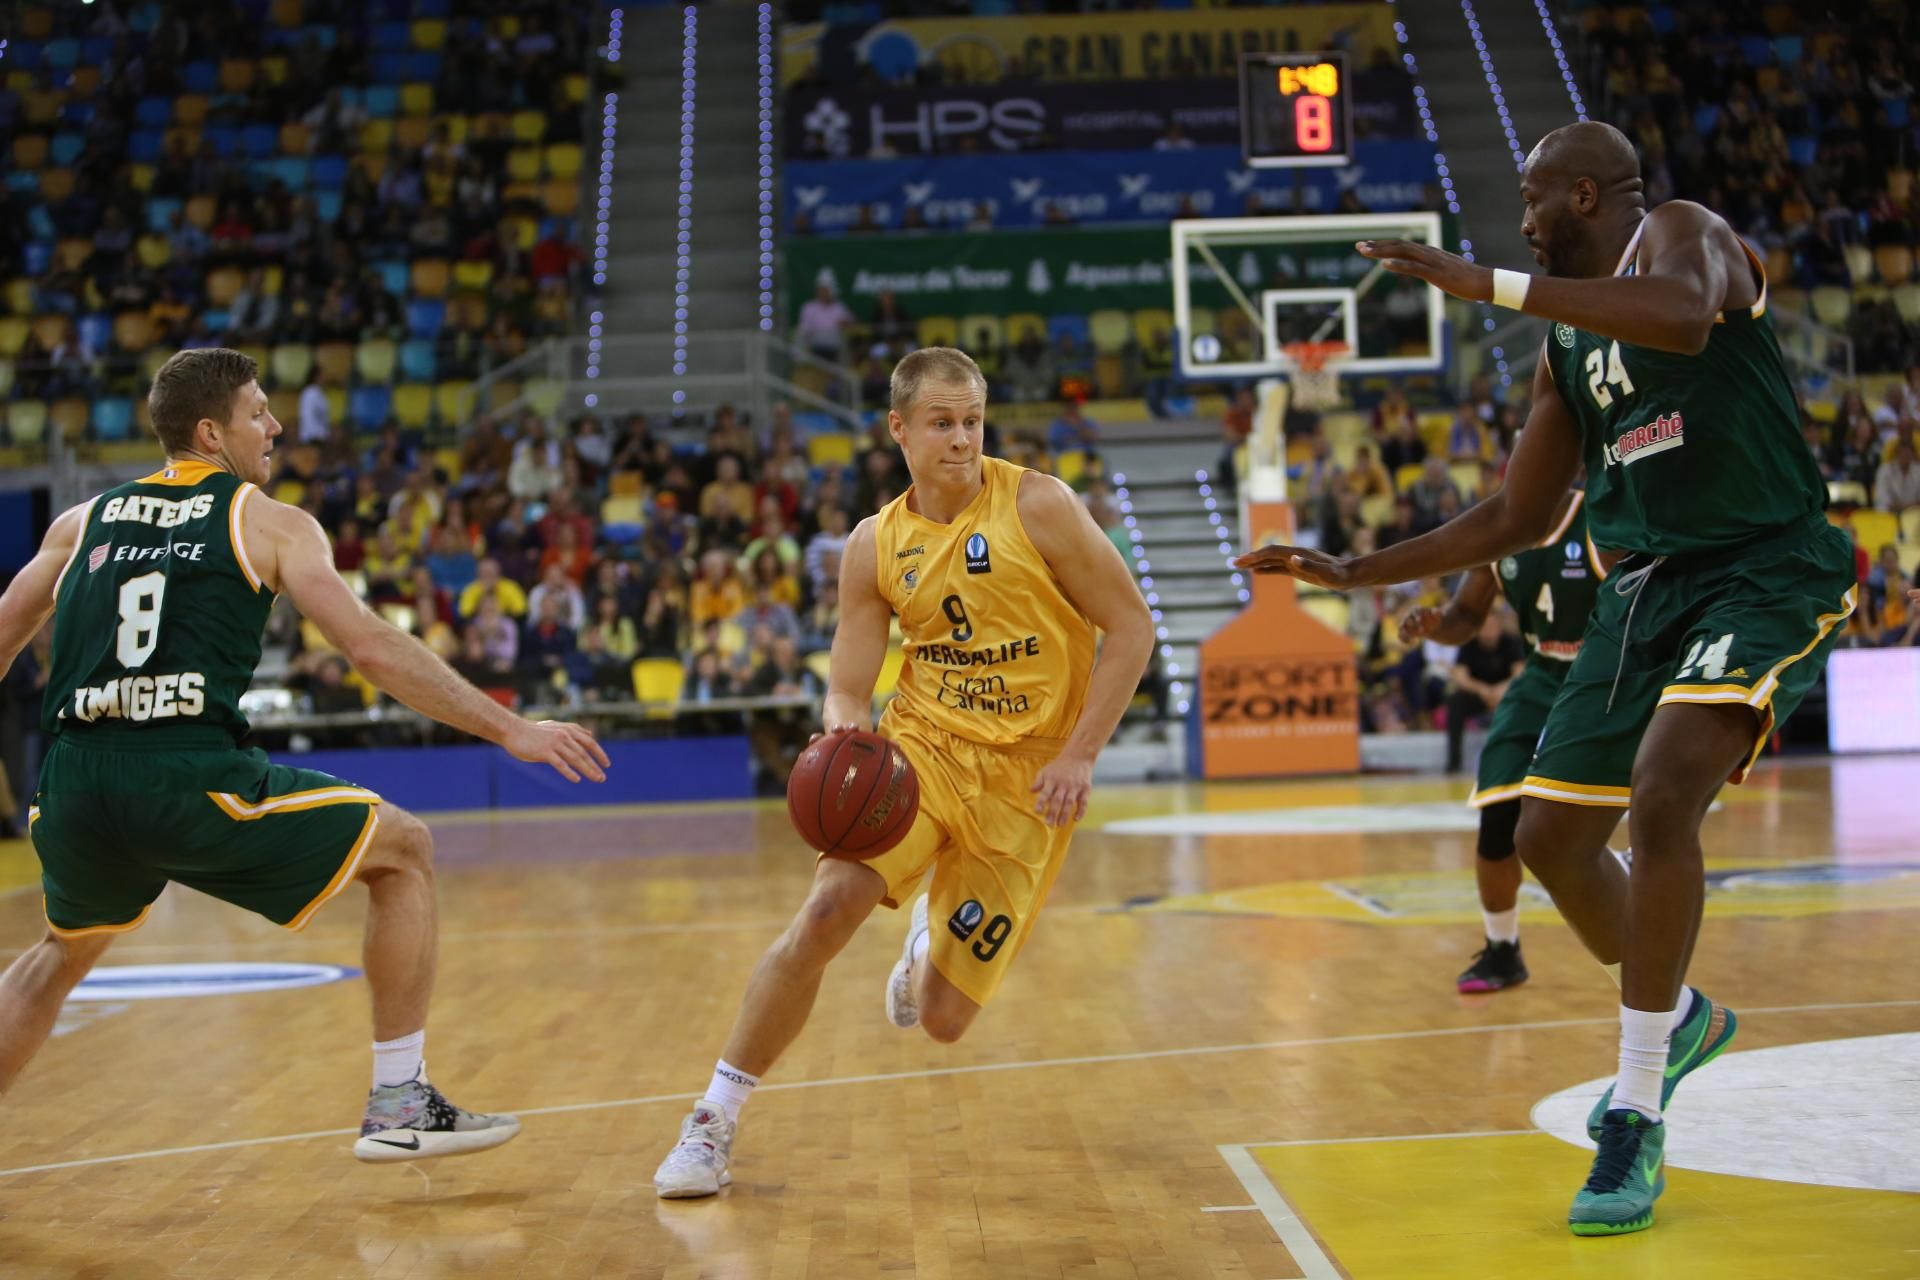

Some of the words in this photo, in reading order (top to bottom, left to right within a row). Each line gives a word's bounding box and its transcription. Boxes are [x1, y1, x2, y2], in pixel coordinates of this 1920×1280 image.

[869, 98, 1046, 151] HPS
[1296, 95, 1332, 152] 8
[1585, 339, 1635, 410] 24
[101, 494, 214, 528] GATENS
[113, 540, 206, 562] EIFFGE
[895, 544, 925, 561] PALDING
[116, 570, 166, 669] 8
[942, 594, 973, 642] 9
[1536, 583, 1554, 623] 4
[916, 636, 1040, 666] HERBALIFE
[1675, 633, 1735, 680] 24
[942, 669, 1005, 696] Gran
[1206, 663, 1346, 692] SPORT
[1208, 693, 1351, 723] ZONE
[972, 914, 1012, 962] 9
